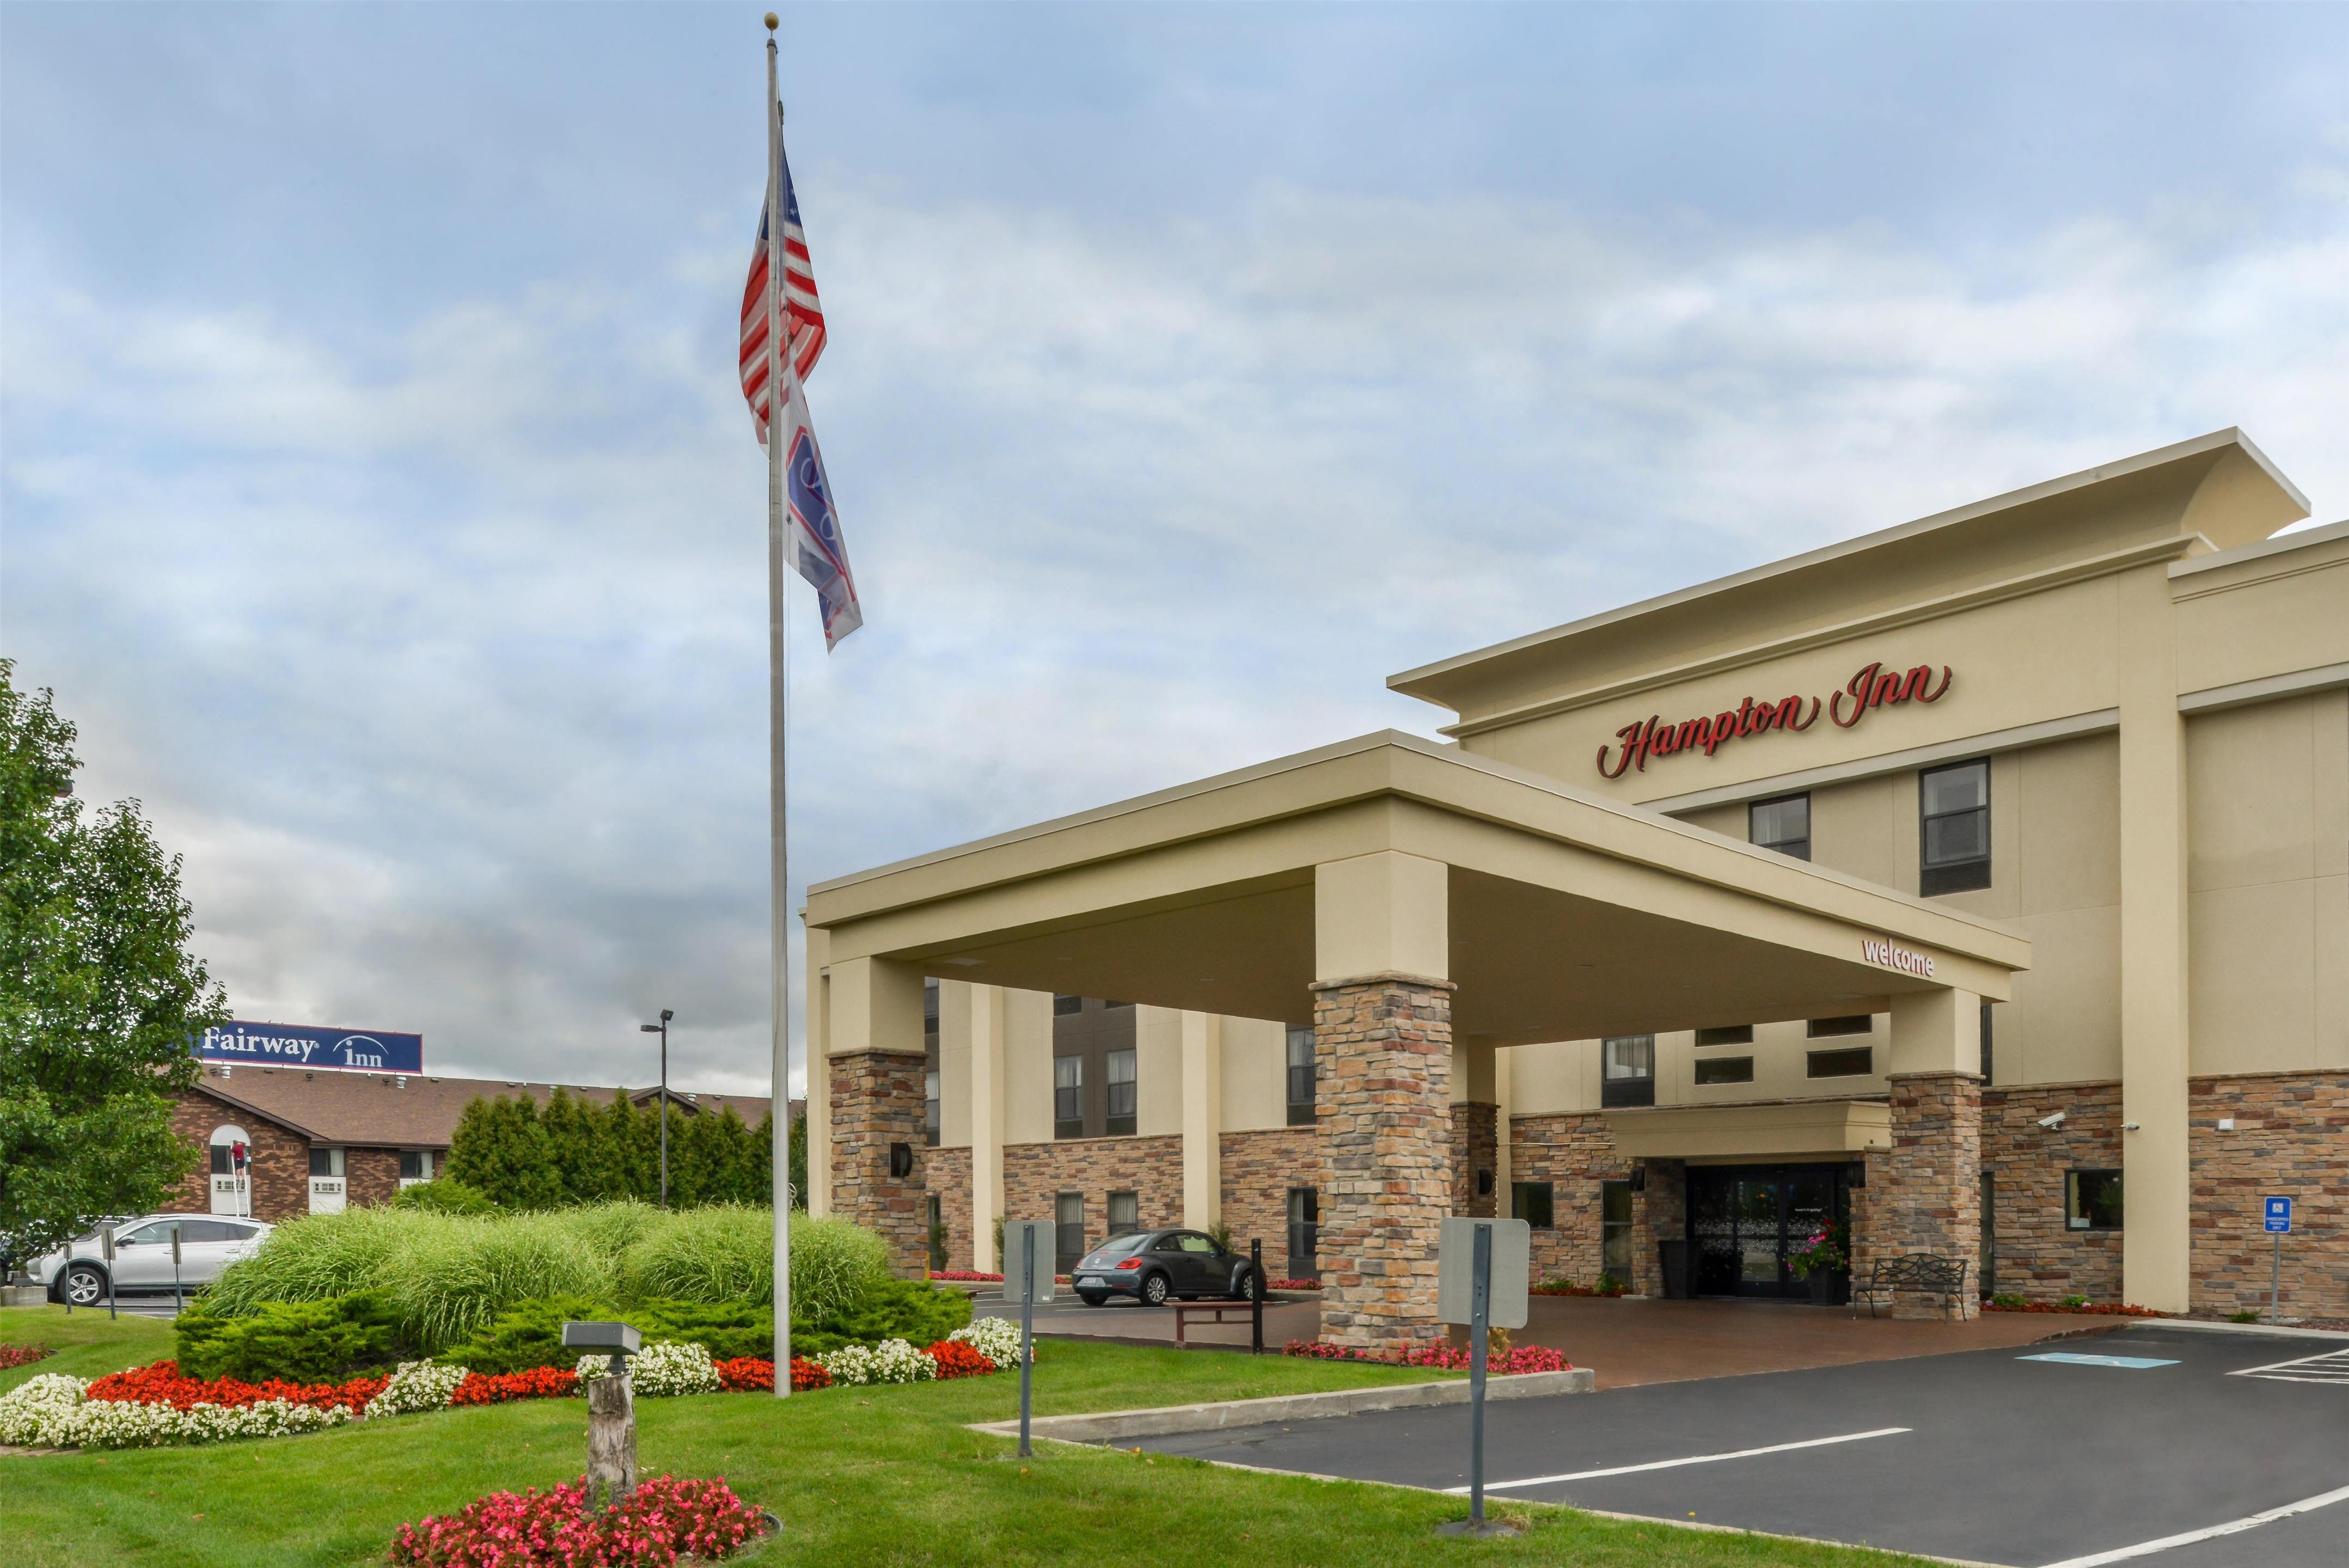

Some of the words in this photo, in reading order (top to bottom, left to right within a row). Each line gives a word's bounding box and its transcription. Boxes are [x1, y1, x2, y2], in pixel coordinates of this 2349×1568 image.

[1596, 695, 1821, 779] Hampton
[1830, 662, 1952, 728] Inn
[1862, 938, 1935, 976] welcome
[202, 1026, 316, 1062] Fairway
[344, 1040, 382, 1067] inn
